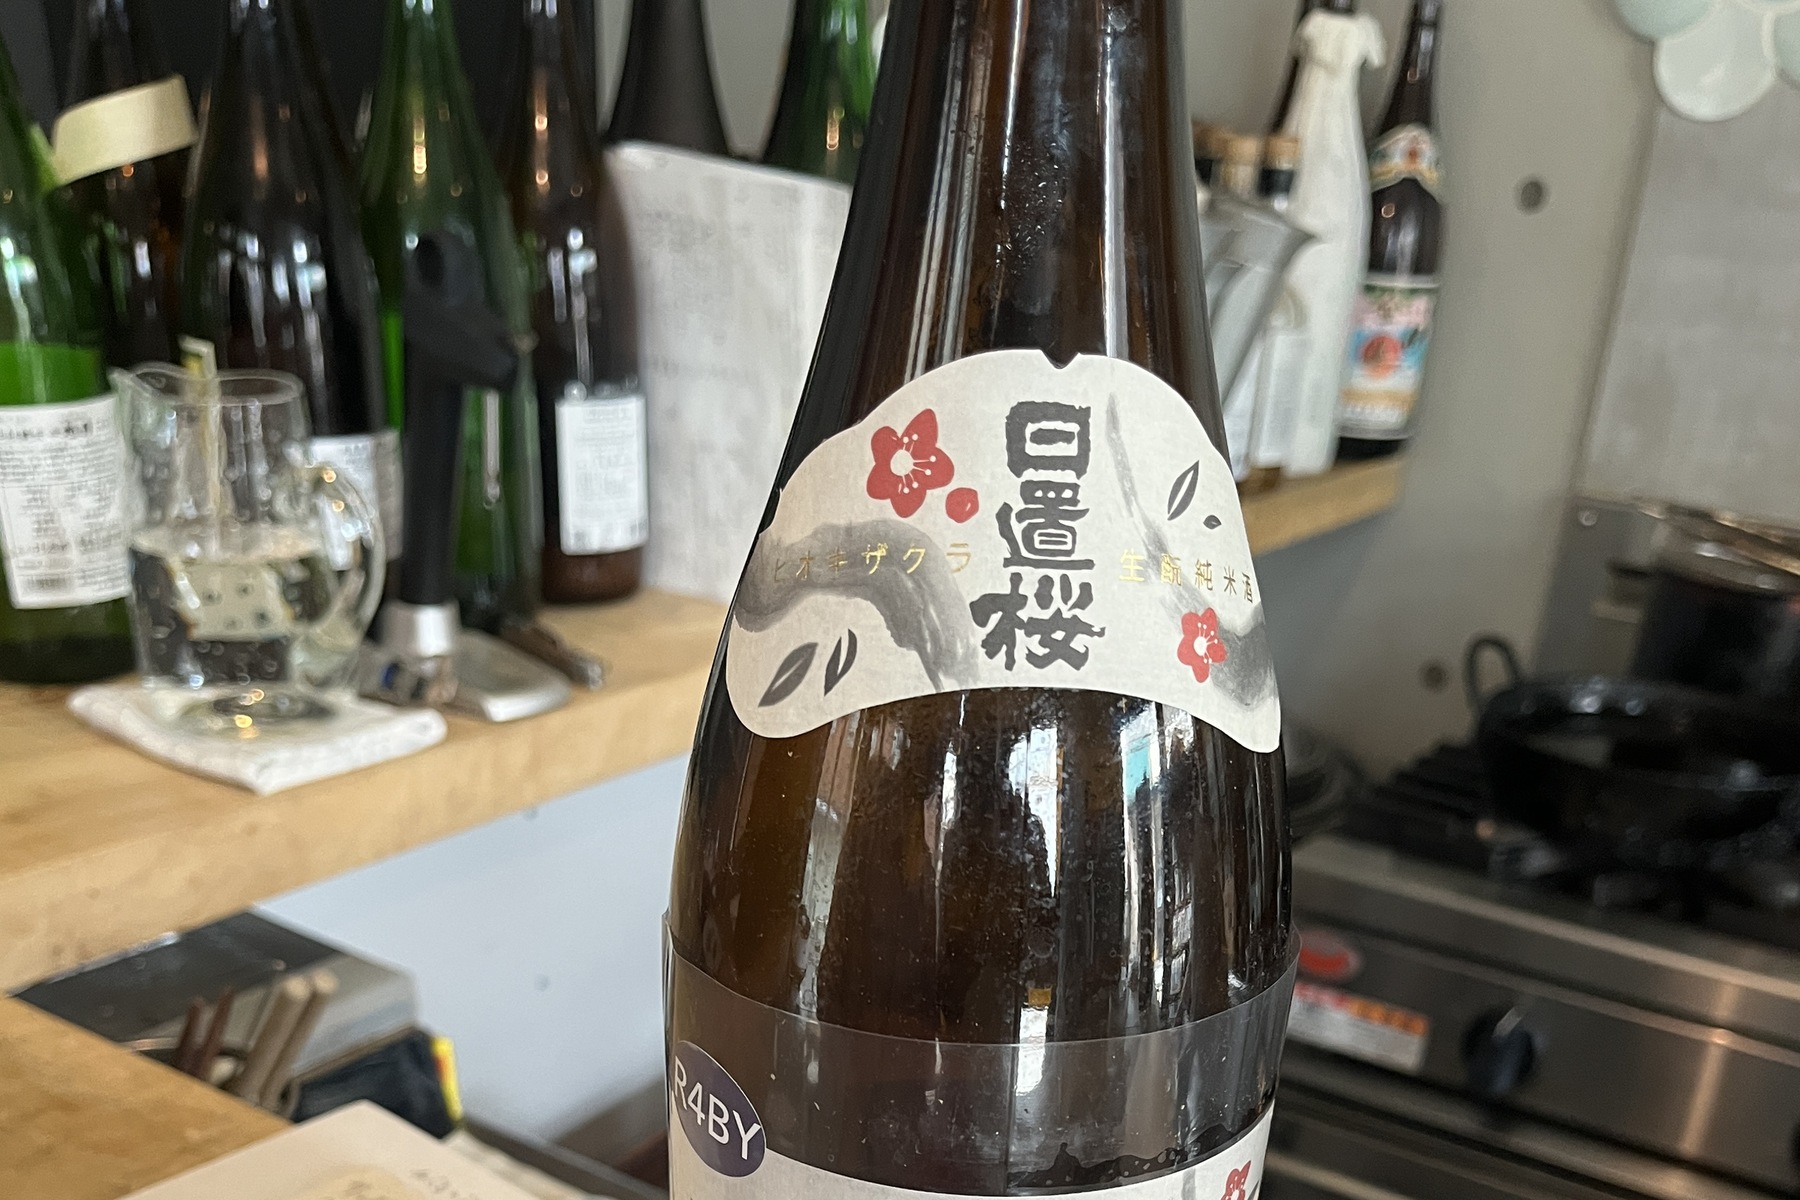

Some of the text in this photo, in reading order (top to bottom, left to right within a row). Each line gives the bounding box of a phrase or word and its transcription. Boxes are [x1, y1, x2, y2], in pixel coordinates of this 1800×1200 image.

[773, 543, 972, 584] ヒオキザクラ
[970, 399, 1107, 672] 日置桜
[674, 1055, 762, 1160] R4BY
